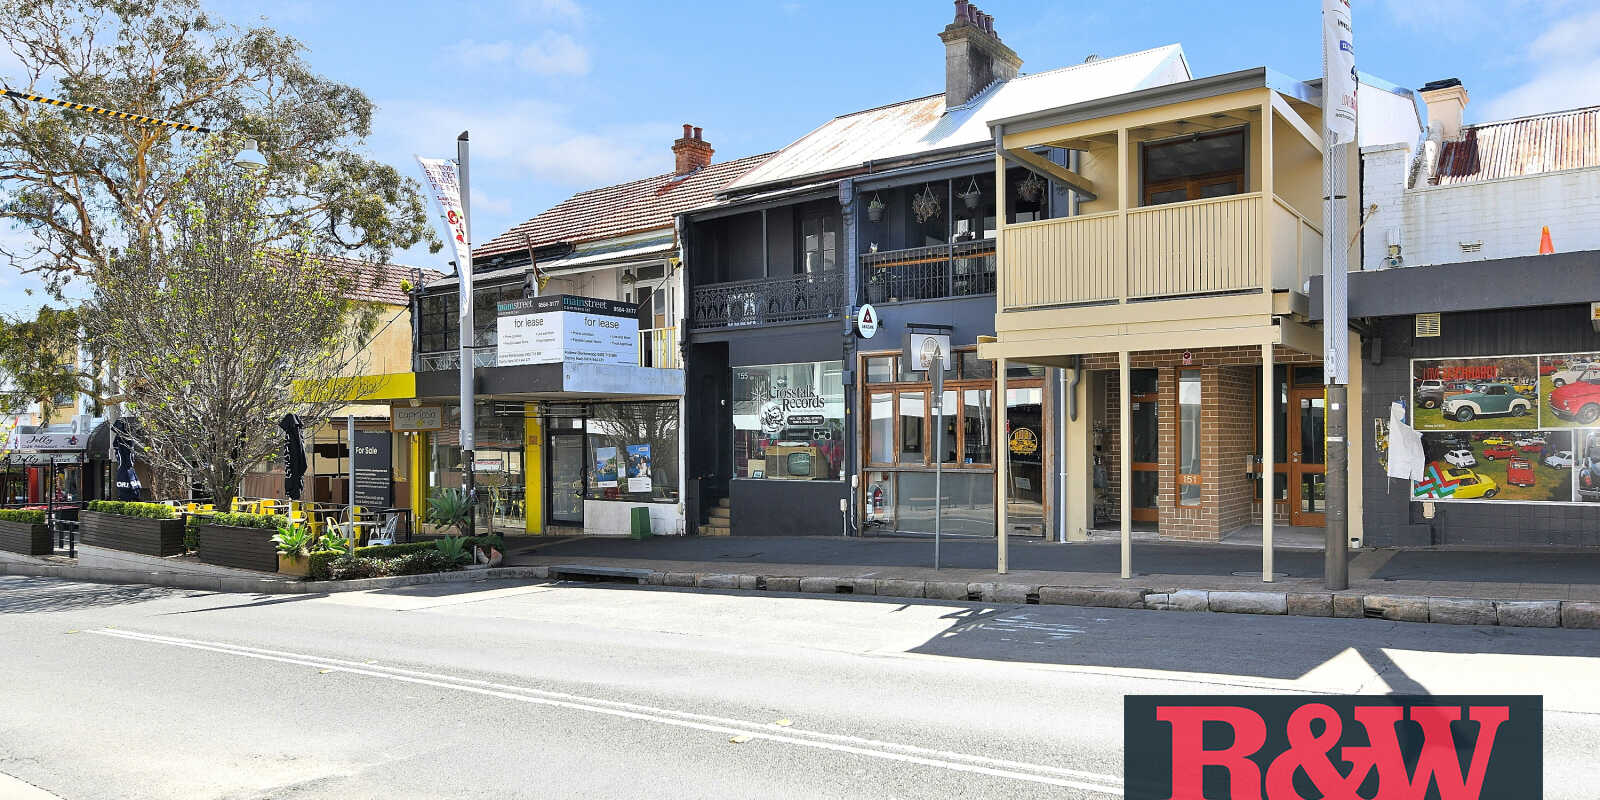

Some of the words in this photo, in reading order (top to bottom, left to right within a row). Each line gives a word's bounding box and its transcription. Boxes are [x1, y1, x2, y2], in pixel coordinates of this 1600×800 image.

[497, 300, 533, 311] mainstreet
[563, 297, 608, 309] mainstreet
[514, 319, 524, 328] for
[525, 318, 544, 327] lease
[584, 317, 596, 327] for
[598, 319, 620, 329] lease
[769, 384, 816, 399] Crosstalk
[782, 394, 825, 412] Records
[355, 446, 365, 455] For
[365, 446, 378, 455] Sale
[1183, 475, 1198, 484] 151
